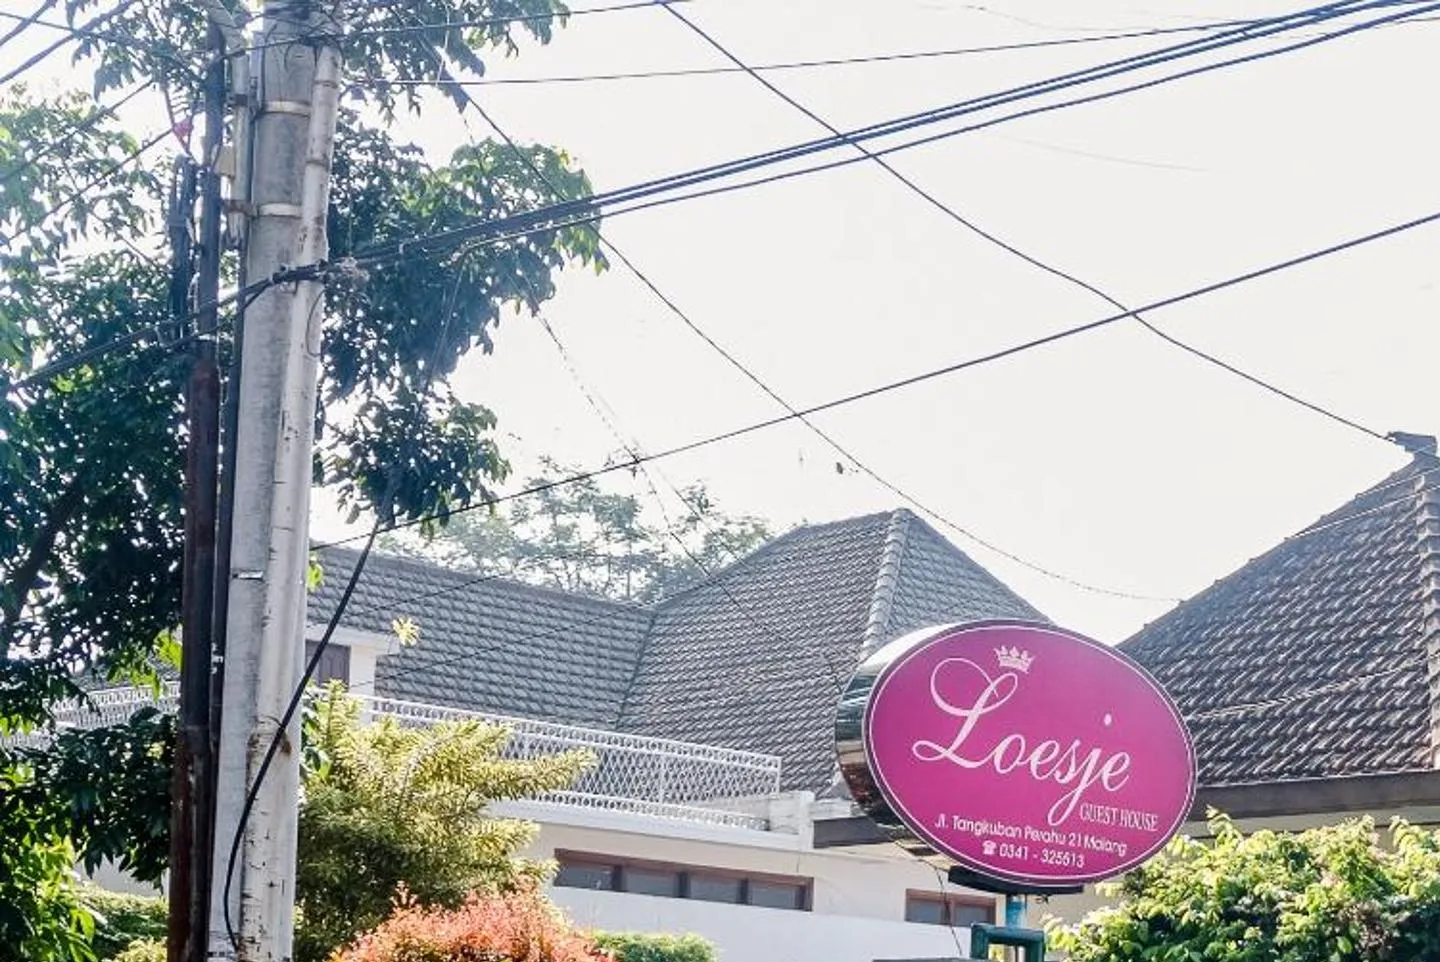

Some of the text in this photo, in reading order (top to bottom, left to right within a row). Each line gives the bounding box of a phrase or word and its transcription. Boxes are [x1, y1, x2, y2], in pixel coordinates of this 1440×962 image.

[912, 658, 1130, 825] Loesje
[1080, 803, 1159, 832] GUEST HOUSE
[951, 815, 1022, 838] Tangkuban
[1024, 825, 1066, 846] Perahu
[1068, 832, 1081, 847] 21
[1083, 834, 1128, 857] Malang
[999, 842, 1028, 860] 0341
